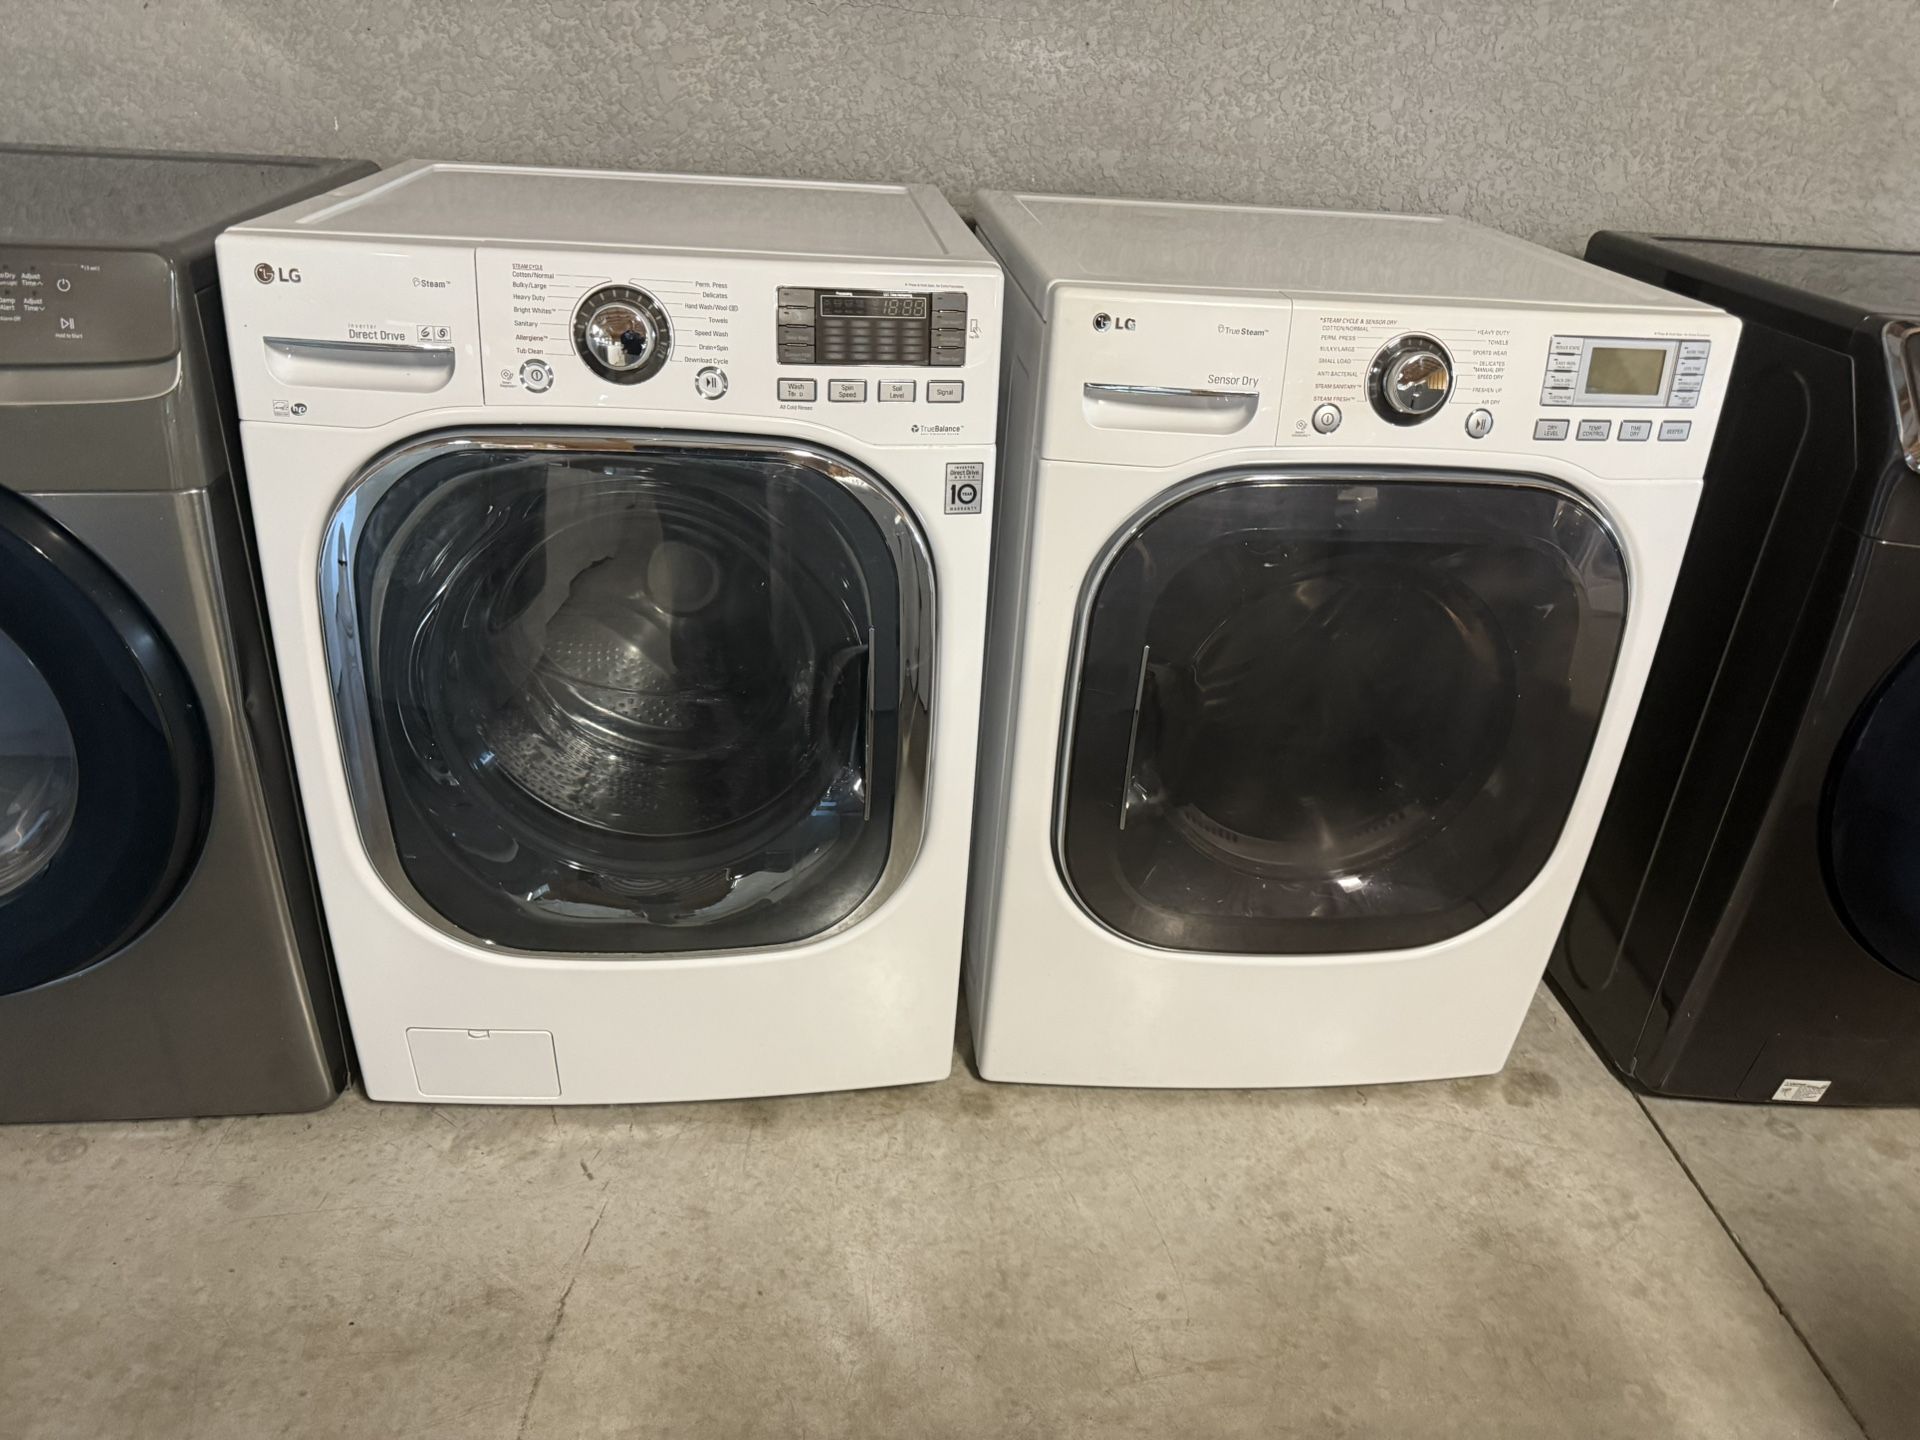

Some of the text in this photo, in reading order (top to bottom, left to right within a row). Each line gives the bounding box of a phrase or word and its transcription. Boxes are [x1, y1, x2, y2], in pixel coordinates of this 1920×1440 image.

[21, 272, 41, 280] Adjust
[278, 267, 301, 283] LG
[512, 271, 554, 279] Cotton/Normal
[512, 281, 547, 290] Bulky/Large
[532, 294, 545, 302] Duty
[702, 291, 728, 299] Delicates
[513, 306, 531, 314] Bright
[514, 320, 538, 328] Sanitary
[708, 316, 728, 324] Towels
[1115, 317, 1136, 331] LG
[349, 329, 406, 341] Direct Drive
[694, 329, 712, 337] Speed
[684, 356, 728, 365] Download Cycle
[1208, 374, 1259, 389] Sensor Dry
[951, 483, 977, 505] 10
